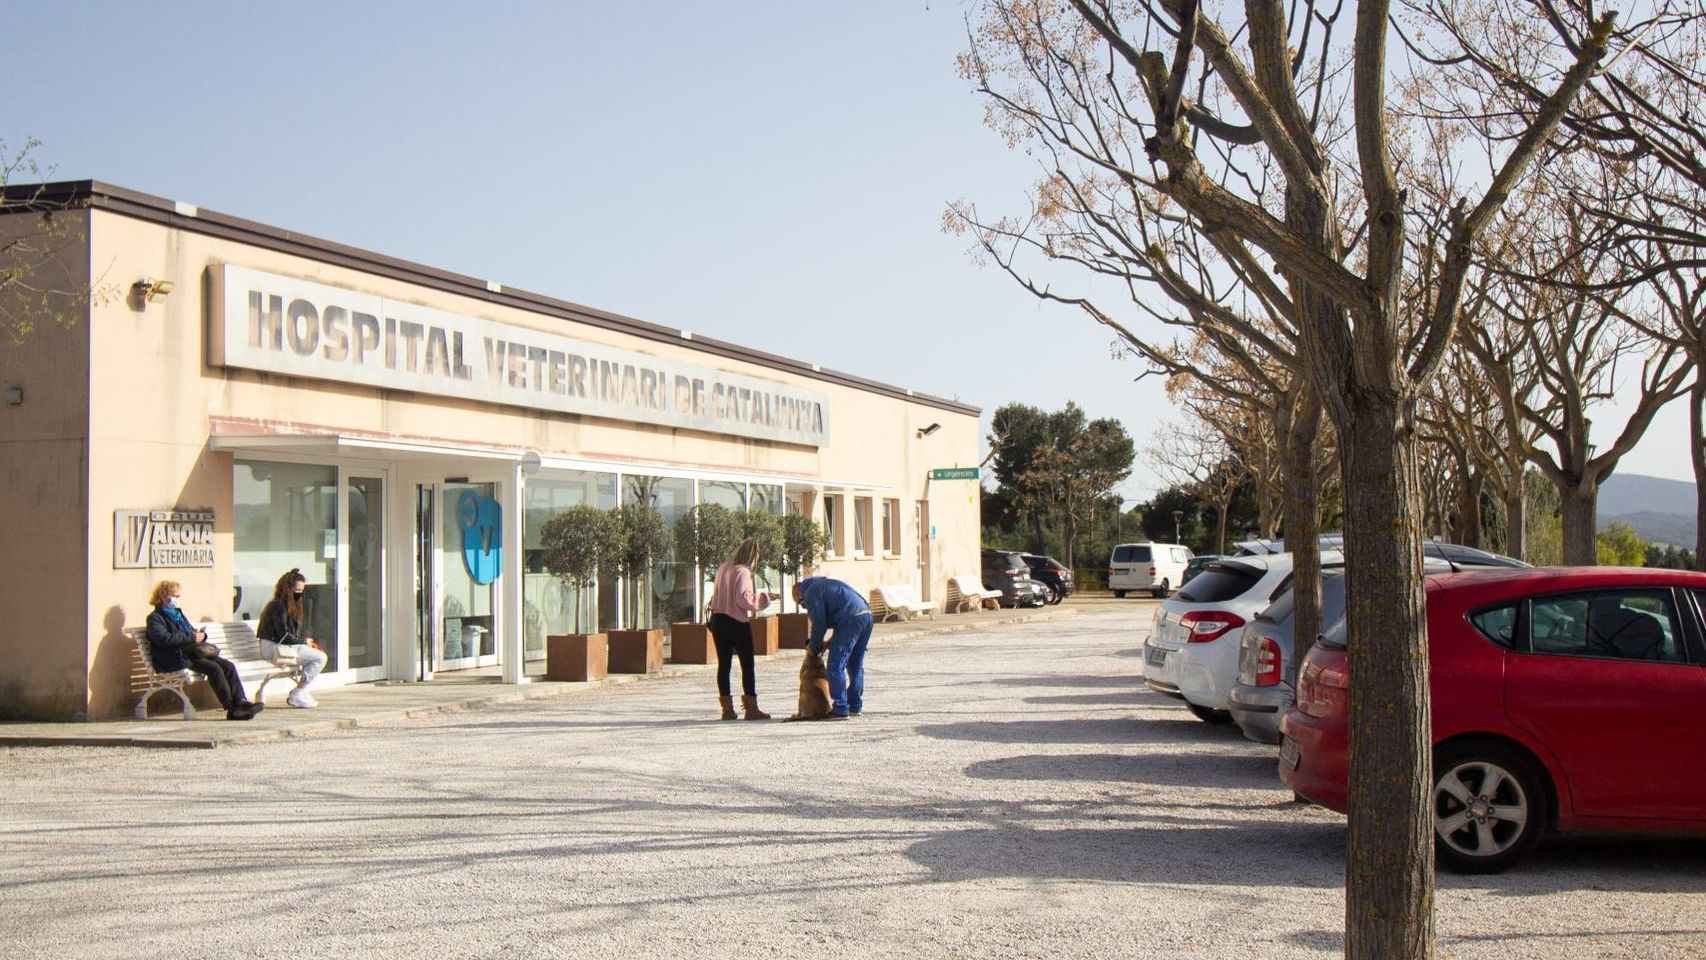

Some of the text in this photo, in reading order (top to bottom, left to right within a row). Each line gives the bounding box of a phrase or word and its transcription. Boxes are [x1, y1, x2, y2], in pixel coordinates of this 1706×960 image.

[248, 290, 824, 434] HOSPITAL VETERINARI DE CATALUNYA
[150, 522, 214, 545] ANOIA
